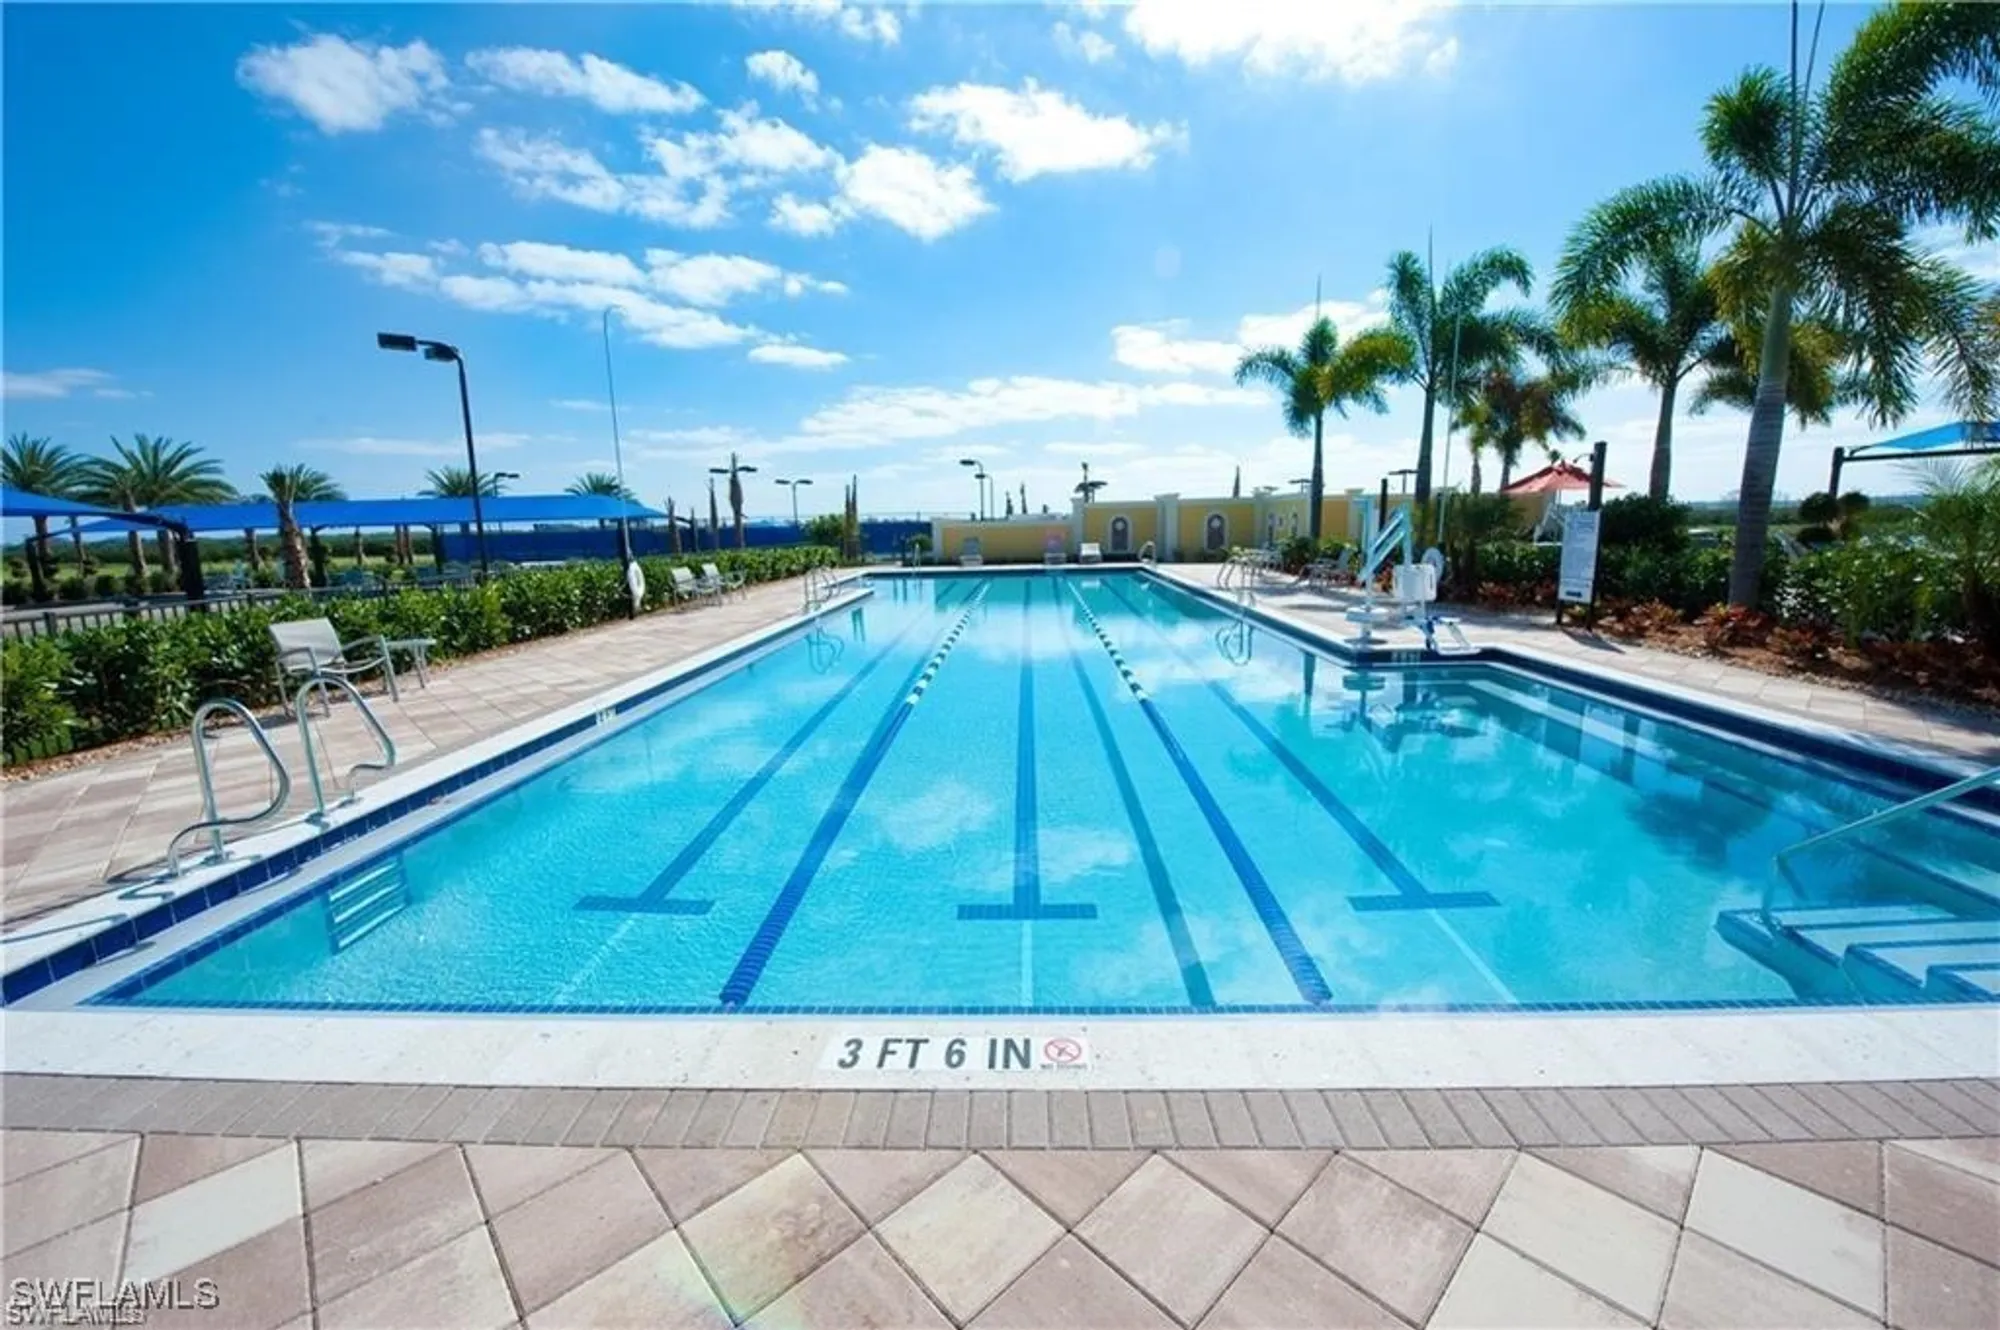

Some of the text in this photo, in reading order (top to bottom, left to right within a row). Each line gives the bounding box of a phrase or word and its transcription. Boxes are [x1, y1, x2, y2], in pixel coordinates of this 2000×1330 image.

[837, 1038, 1031, 1070] 3 FT 6 IN
